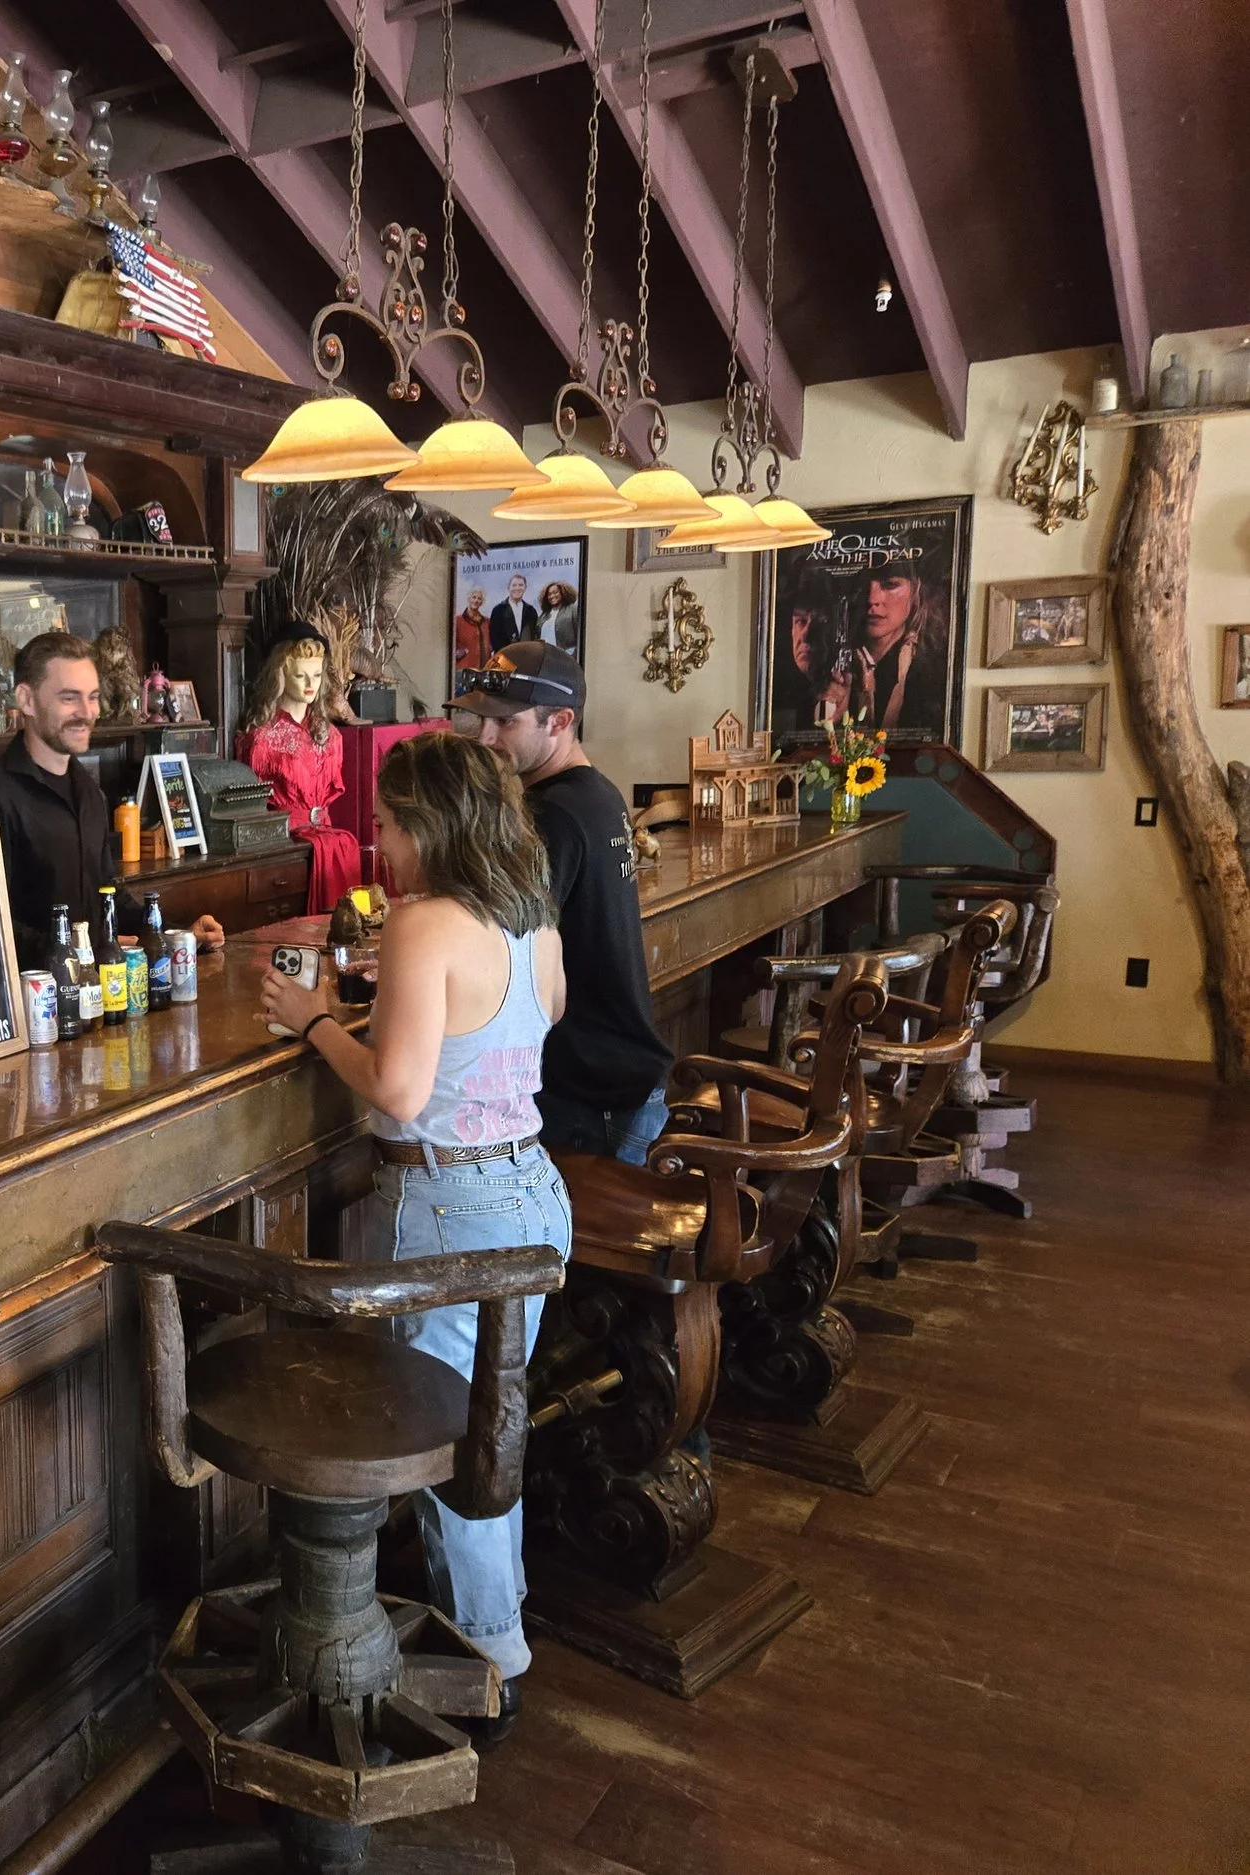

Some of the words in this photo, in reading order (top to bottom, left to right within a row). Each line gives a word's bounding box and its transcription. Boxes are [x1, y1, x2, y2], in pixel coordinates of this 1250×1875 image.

[149, 514, 169, 531] 32
[812, 540, 839, 552] THE
[838, 534, 901, 553] QUICK
[462, 564, 480, 575] LONG
[481, 563, 511, 573] BRANCH
[513, 560, 541, 570] SALOON
[549, 557, 575, 568] FARMS
[806, 550, 838, 561] AND
[836, 552, 868, 564] THE
[868, 547, 924, 569] DEAD
